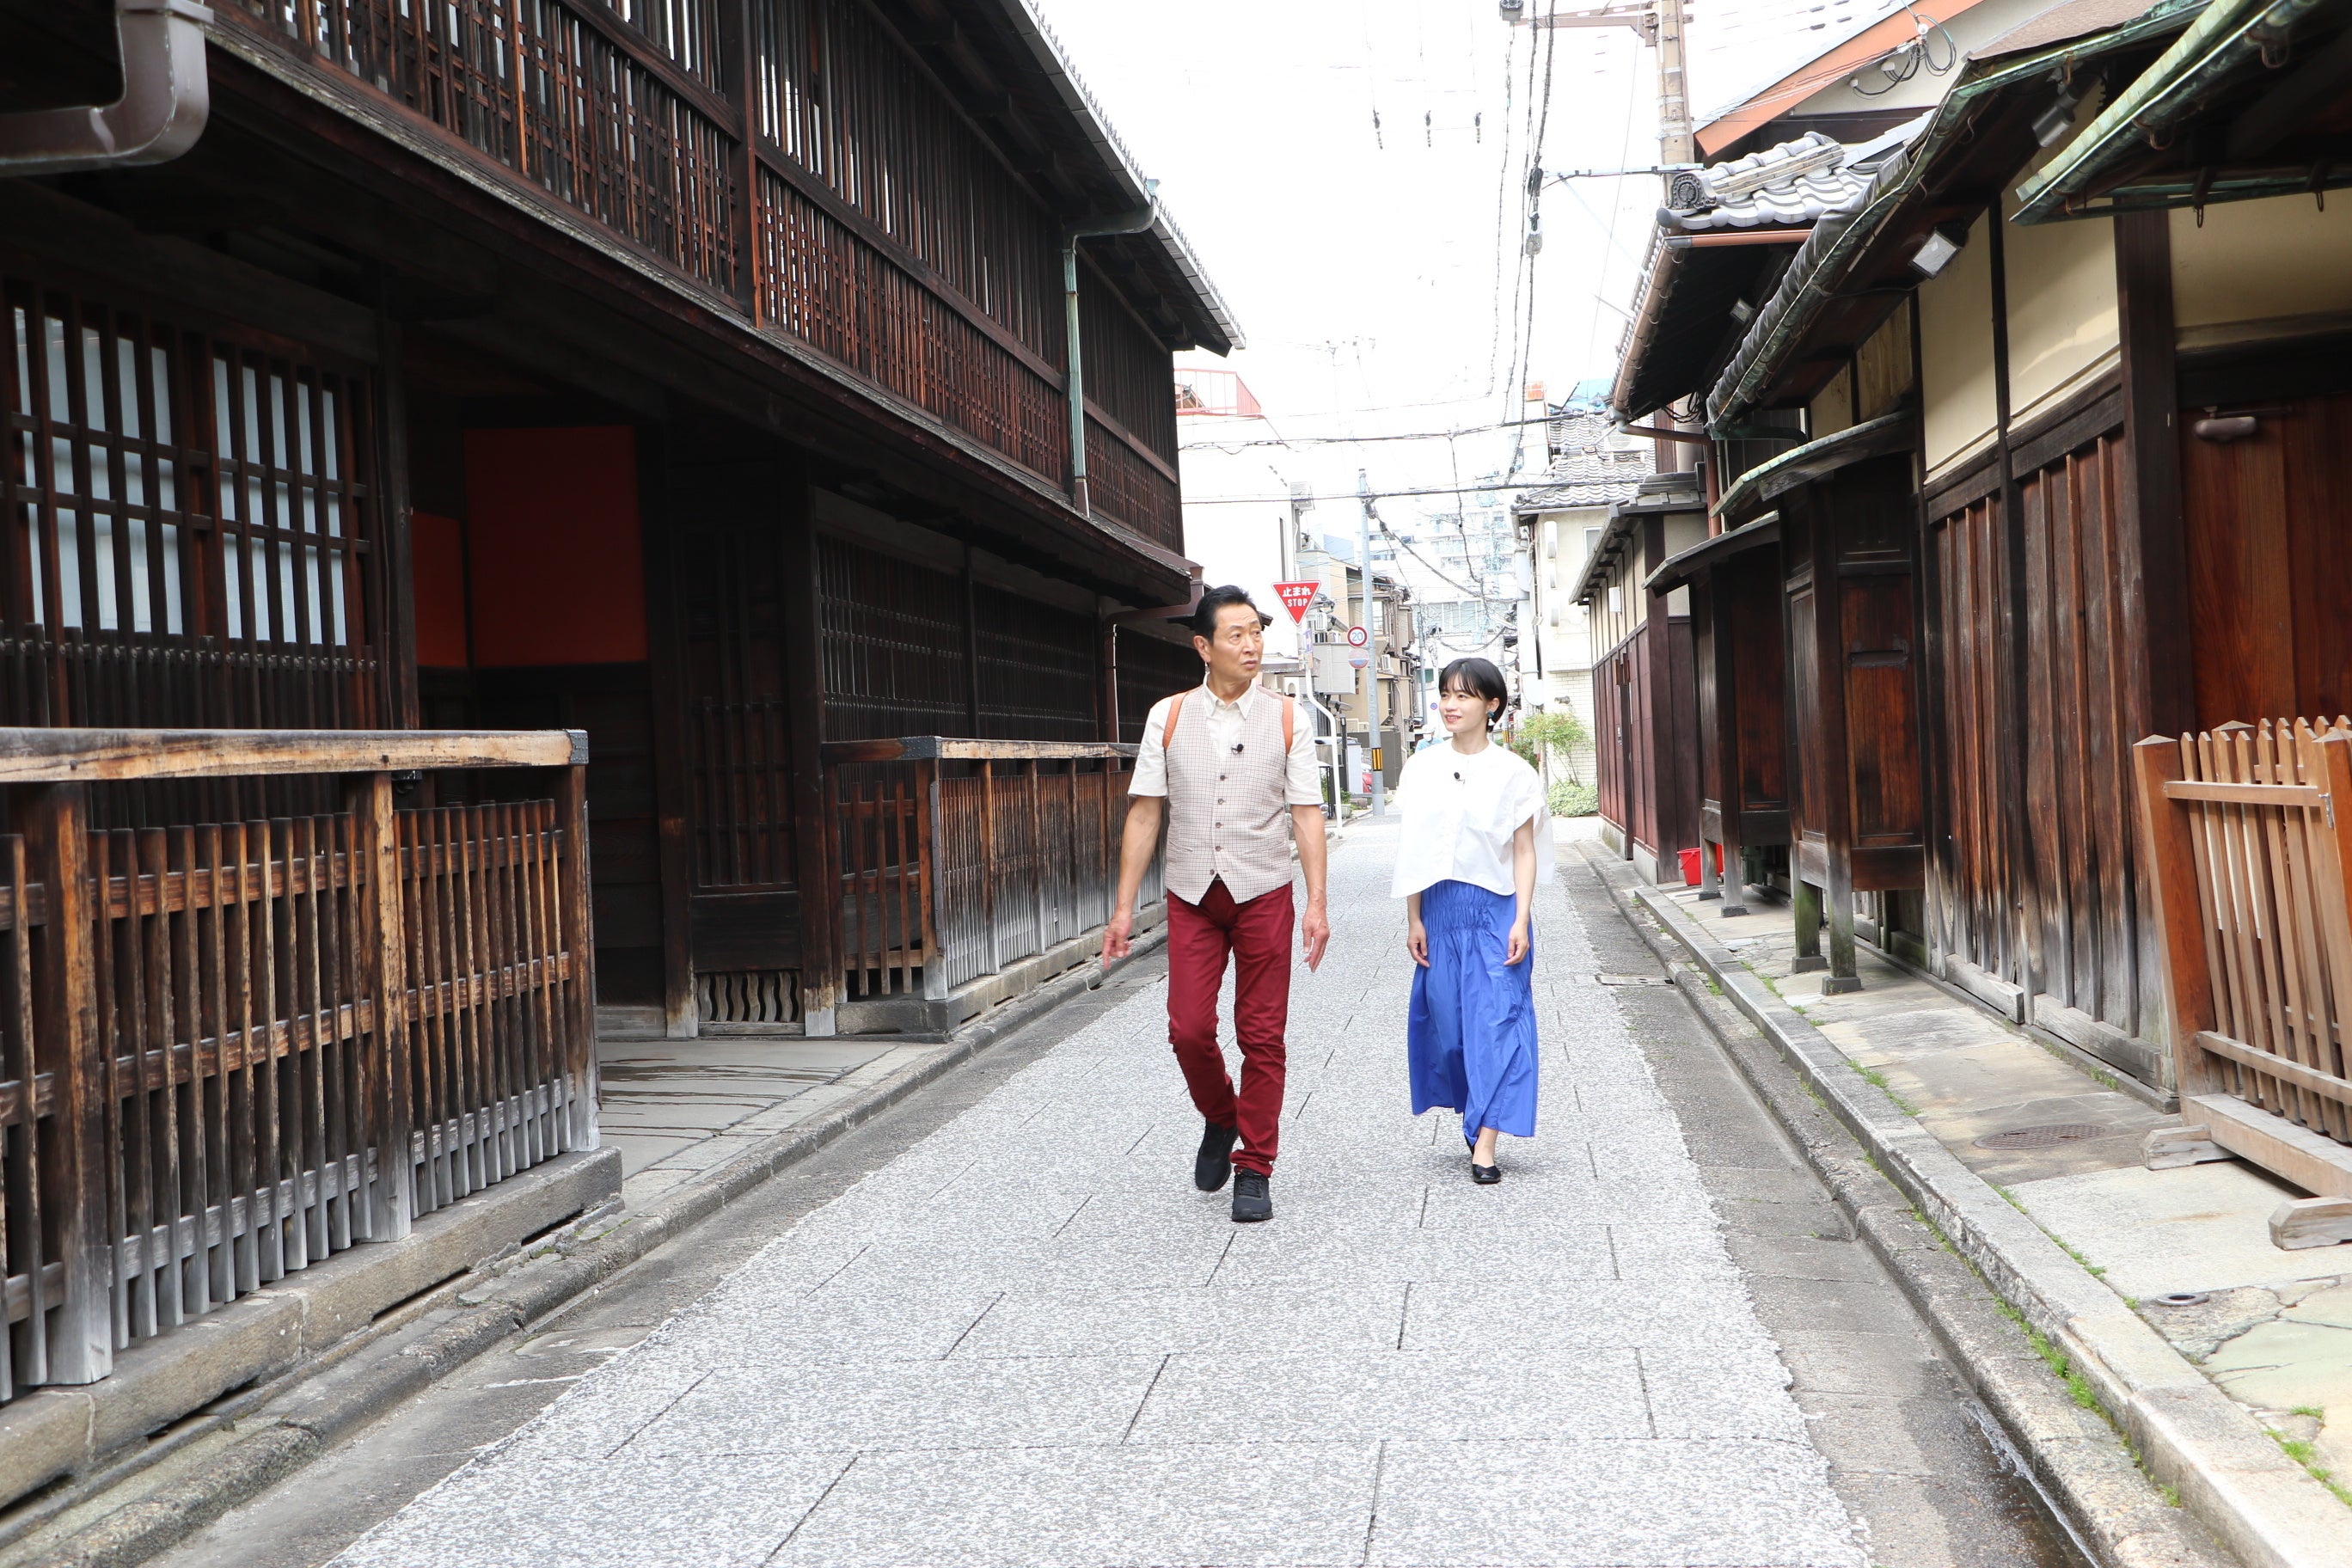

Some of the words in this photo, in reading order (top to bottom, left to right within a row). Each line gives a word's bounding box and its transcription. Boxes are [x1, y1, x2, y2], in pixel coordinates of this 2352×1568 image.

[1282, 585, 1312, 597] 止まれ
[1287, 597, 1308, 607] STOP
[1351, 631, 1363, 641] 20
